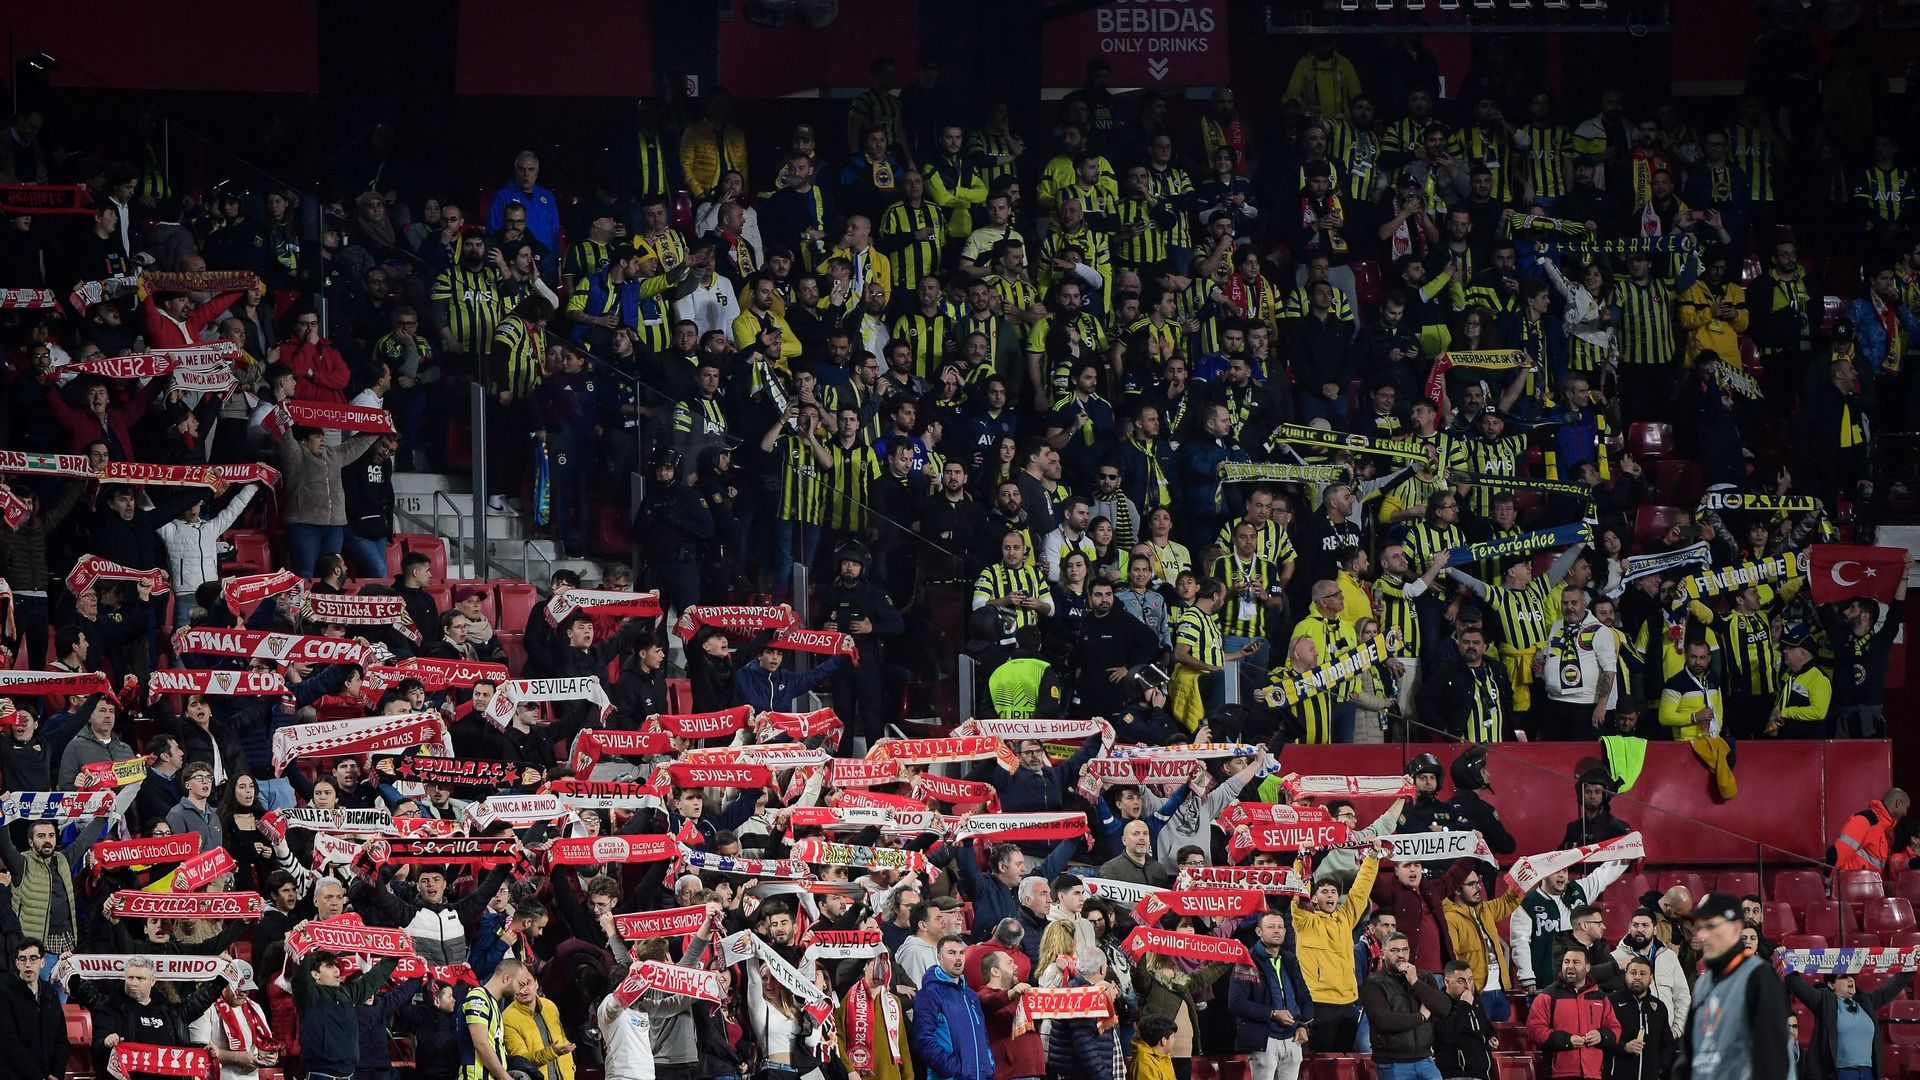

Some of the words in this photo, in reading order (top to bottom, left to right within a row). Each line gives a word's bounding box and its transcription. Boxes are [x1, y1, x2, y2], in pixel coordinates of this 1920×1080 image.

[1096, 8, 1216, 33] BEBIDAS
[1101, 38, 1143, 53] ONLY
[1149, 38, 1208, 52] DRINKS
[1528, 150, 1554, 160] AVIS
[1874, 191, 1901, 202] AVIS
[1501, 354, 1511, 363] SK
[1323, 432, 1338, 442] OF
[111, 465, 173, 480] SEVILLA
[1485, 460, 1513, 471] AVIS
[567, 594, 589, 605] Dicen
[591, 598, 604, 607] que
[606, 599, 630, 607] nunca
[630, 599, 638, 607] se
[317, 601, 372, 617] SEVILLA
[375, 603, 401, 617] F.C.
[698, 605, 785, 621] PENTACAMPEÓN
[1518, 610, 1543, 621] AVIS
[187, 630, 248, 653] FINAL
[728, 626, 758, 638] NUNC
[788, 633, 833, 646] RINDAS
[304, 639, 363, 661] COPA
[3, 676, 24, 685] que
[27, 676, 62, 685] nunca
[65, 677, 76, 685] se
[79, 675, 105, 685] rinde
[248, 673, 288, 692] COP
[487, 670, 506, 681] 2005
[531, 680, 577, 694] SEVILLA
[579, 678, 593, 692] FC
[305, 724, 337, 737] SEVILLA
[679, 717, 719, 732] SEVILLA
[720, 714, 734, 729] FC
[382, 731, 414, 745] SEVILLA
[593, 733, 634, 748] SEVILLA
[636, 734, 650, 748] FC
[893, 737, 964, 755] SEVILLA
[975, 738, 994, 751] F.C.
[414, 756, 476, 775] SEVILLA
[476, 760, 505, 777] F.C.
[871, 763, 892, 777] F.C.
[690, 768, 732, 781] SEVILLA
[735, 768, 752, 781] FC
[565, 782, 624, 799] SEVILLA
[627, 784, 647, 799] FC
[921, 778, 958, 796] SEVILLA
[959, 784, 971, 796] FC
[972, 783, 988, 796] 189
[50, 801, 59, 810] 04
[493, 802, 518, 813] NUNCA
[520, 802, 532, 811] ME
[533, 801, 556, 811] RINDO
[284, 809, 316, 822] SEVILLA
[347, 810, 391, 826] BICAMPEO
[970, 819, 998, 830] Dicen
[1000, 822, 1018, 832] que
[1020, 820, 1049, 829] nunca
[1051, 821, 1061, 829] se
[1062, 819, 1086, 829] rinde
[1263, 828, 1315, 846] SEVILLA
[1318, 826, 1335, 843] FC
[103, 842, 192, 863] SevillaFútbolClub
[412, 841, 480, 856] Sevilla
[632, 842, 648, 850] DICEN
[650, 841, 665, 849] QUE
[1396, 836, 1445, 856] SEVILLA
[1449, 834, 1467, 852] FC
[1101, 885, 1144, 902] SEVILL
[131, 898, 197, 913] SEVILLA
[211, 899, 241, 913] F.C.
[1181, 897, 1226, 911] SEVILLA
[1228, 896, 1242, 911] FC
[313, 927, 366, 947] SEVILLA
[373, 935, 395, 950] F.C.
[815, 932, 859, 947] SEVILLA
[862, 932, 879, 947] FC
[1147, 931, 1243, 957] SevillaFútbolClub
[80, 959, 124, 972] NUNC
[168, 960, 217, 973] RINDO
[1799, 952, 1836, 965] SCHALKE
[1841, 953, 1850, 965] 04
[435, 968, 450, 980] FC
[783, 968, 793, 985] TE
[1028, 994, 1082, 1009] SEVILLA
